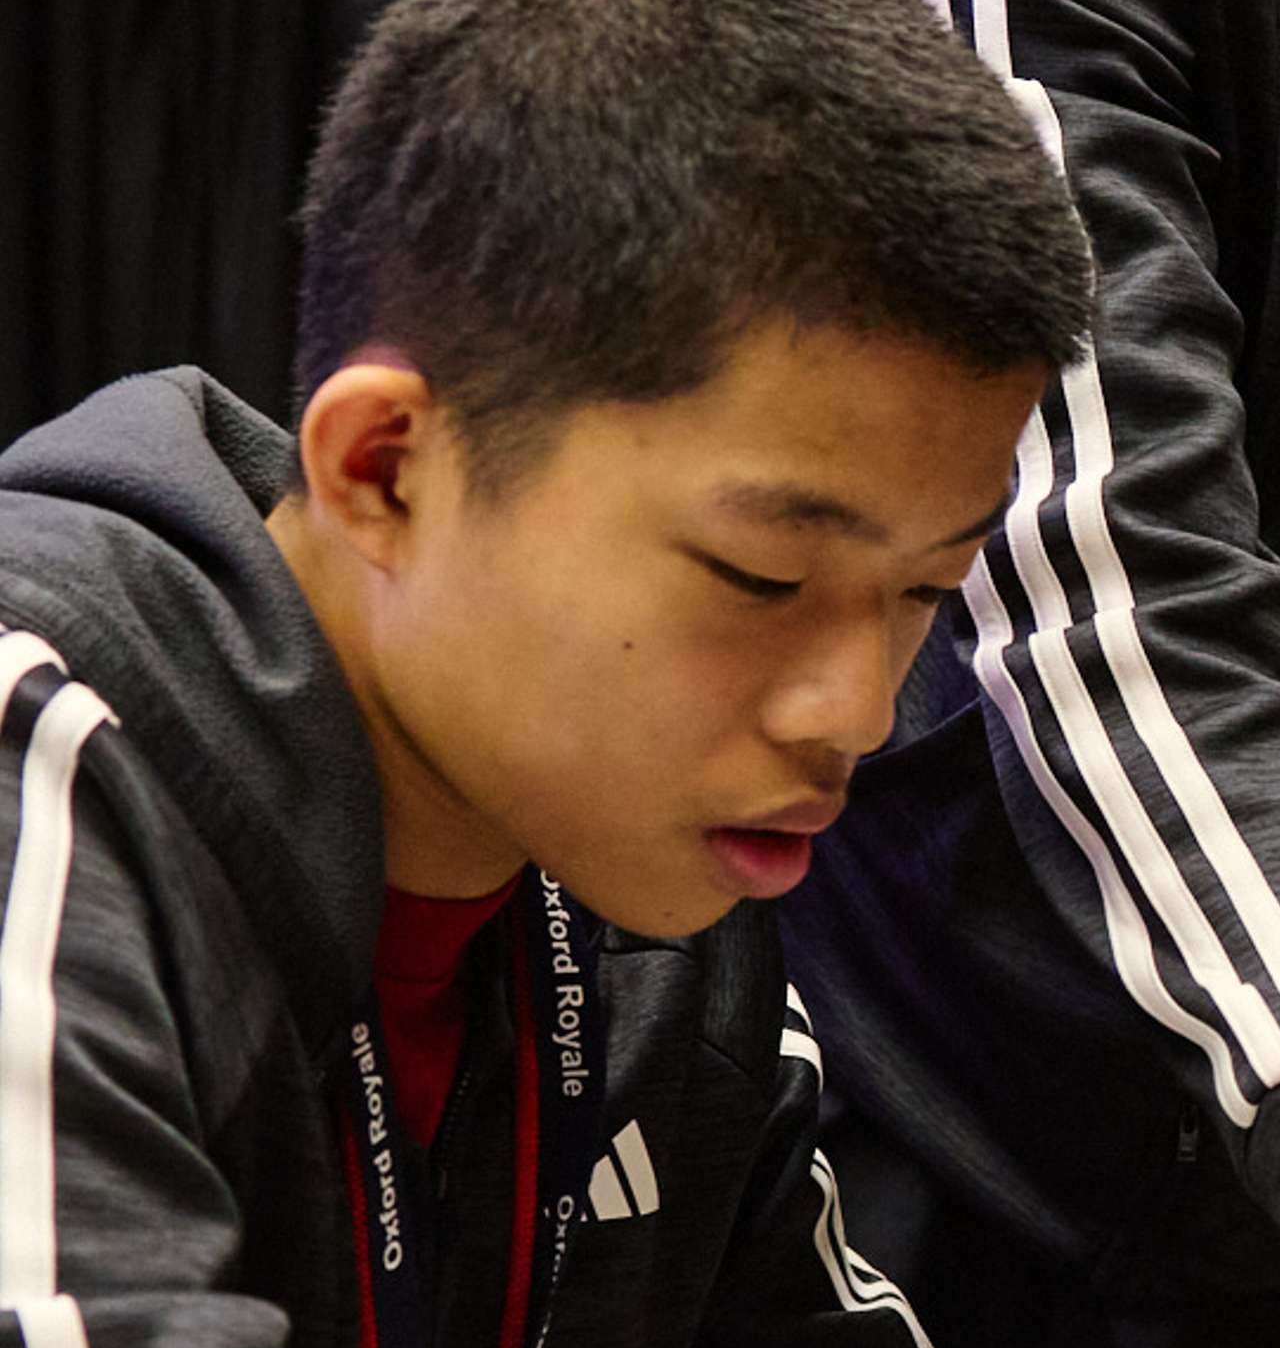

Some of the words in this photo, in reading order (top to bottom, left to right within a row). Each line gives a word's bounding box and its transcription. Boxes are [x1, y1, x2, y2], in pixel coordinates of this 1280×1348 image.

[351, 1022, 388, 1145] Royale
[552, 983, 590, 1097] Royale
[373, 1149, 402, 1271] Oxford
